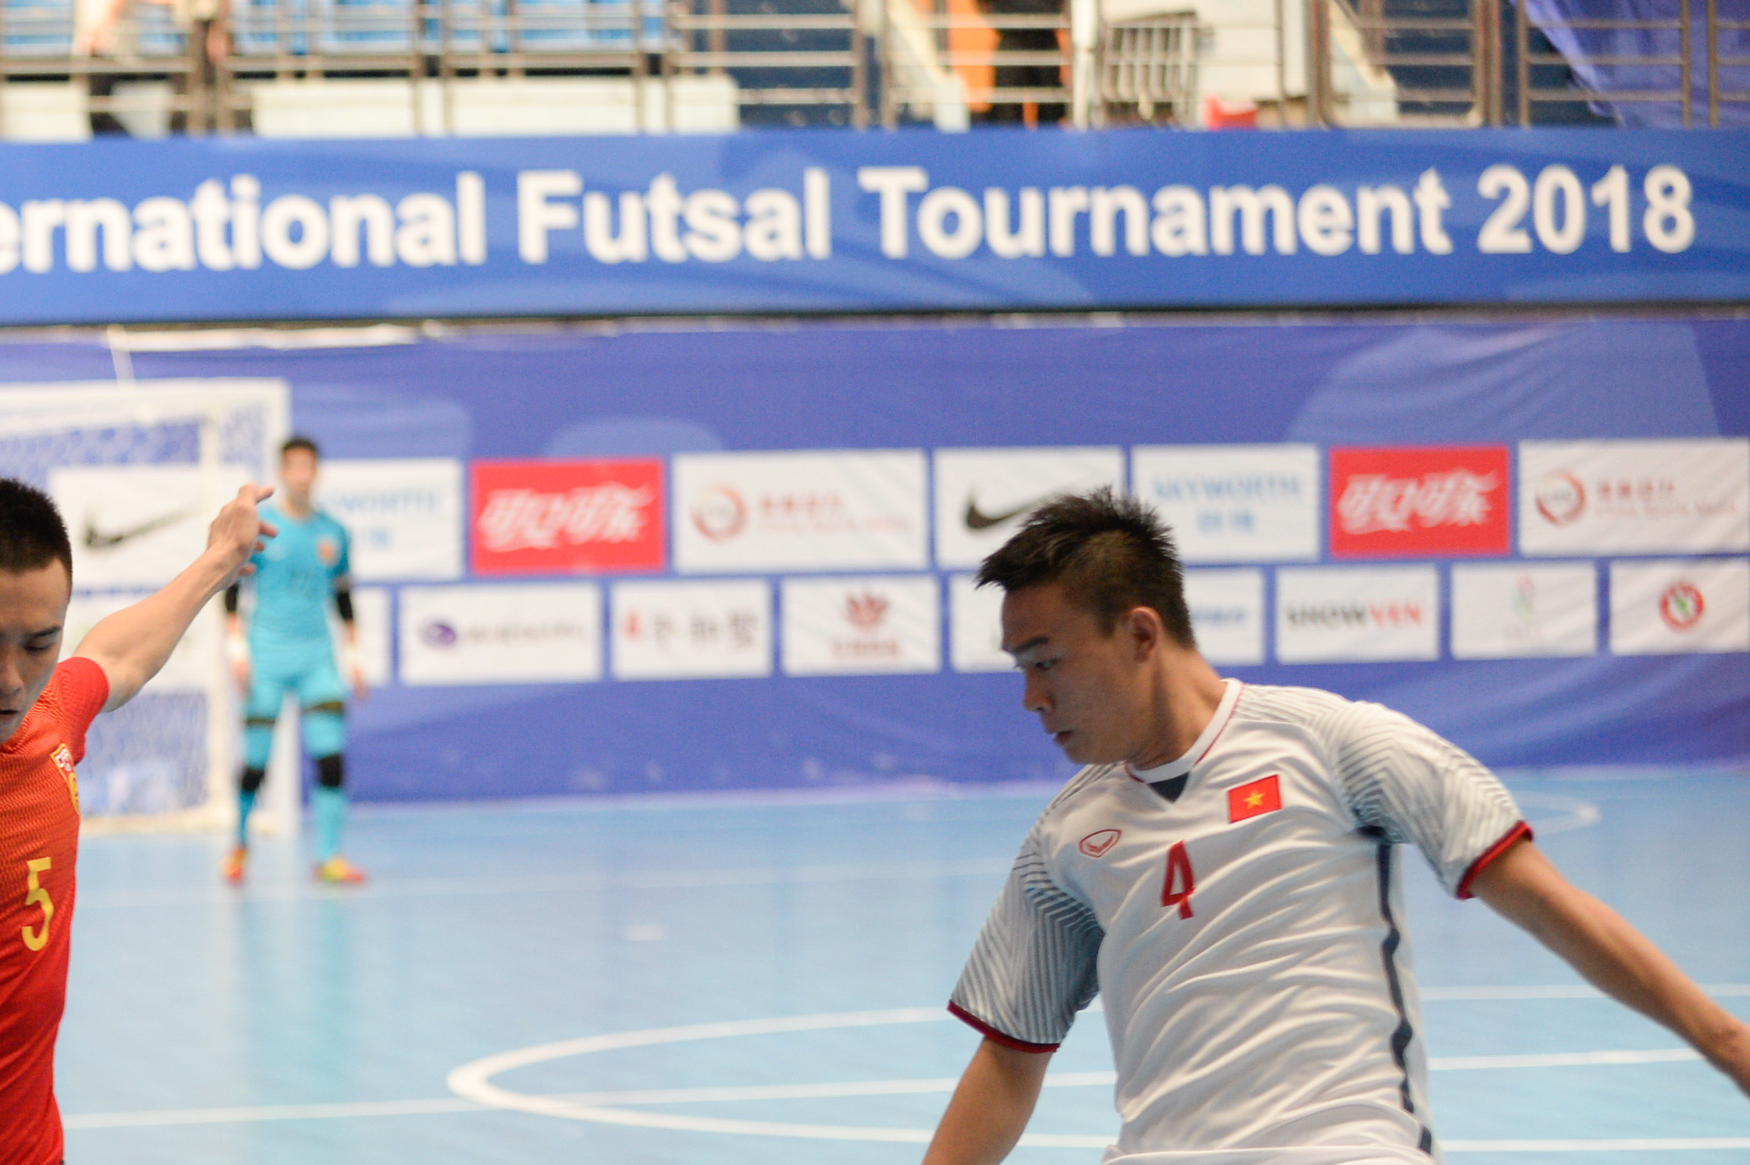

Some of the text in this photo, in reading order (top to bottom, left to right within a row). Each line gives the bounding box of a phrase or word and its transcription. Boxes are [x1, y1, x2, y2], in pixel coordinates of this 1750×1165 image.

[513, 164, 832, 266] Futsal
[854, 164, 1454, 260] Tournament
[1475, 163, 1696, 256] 2018
[21, 856, 55, 951] 5
[1160, 839, 1196, 921] 4
